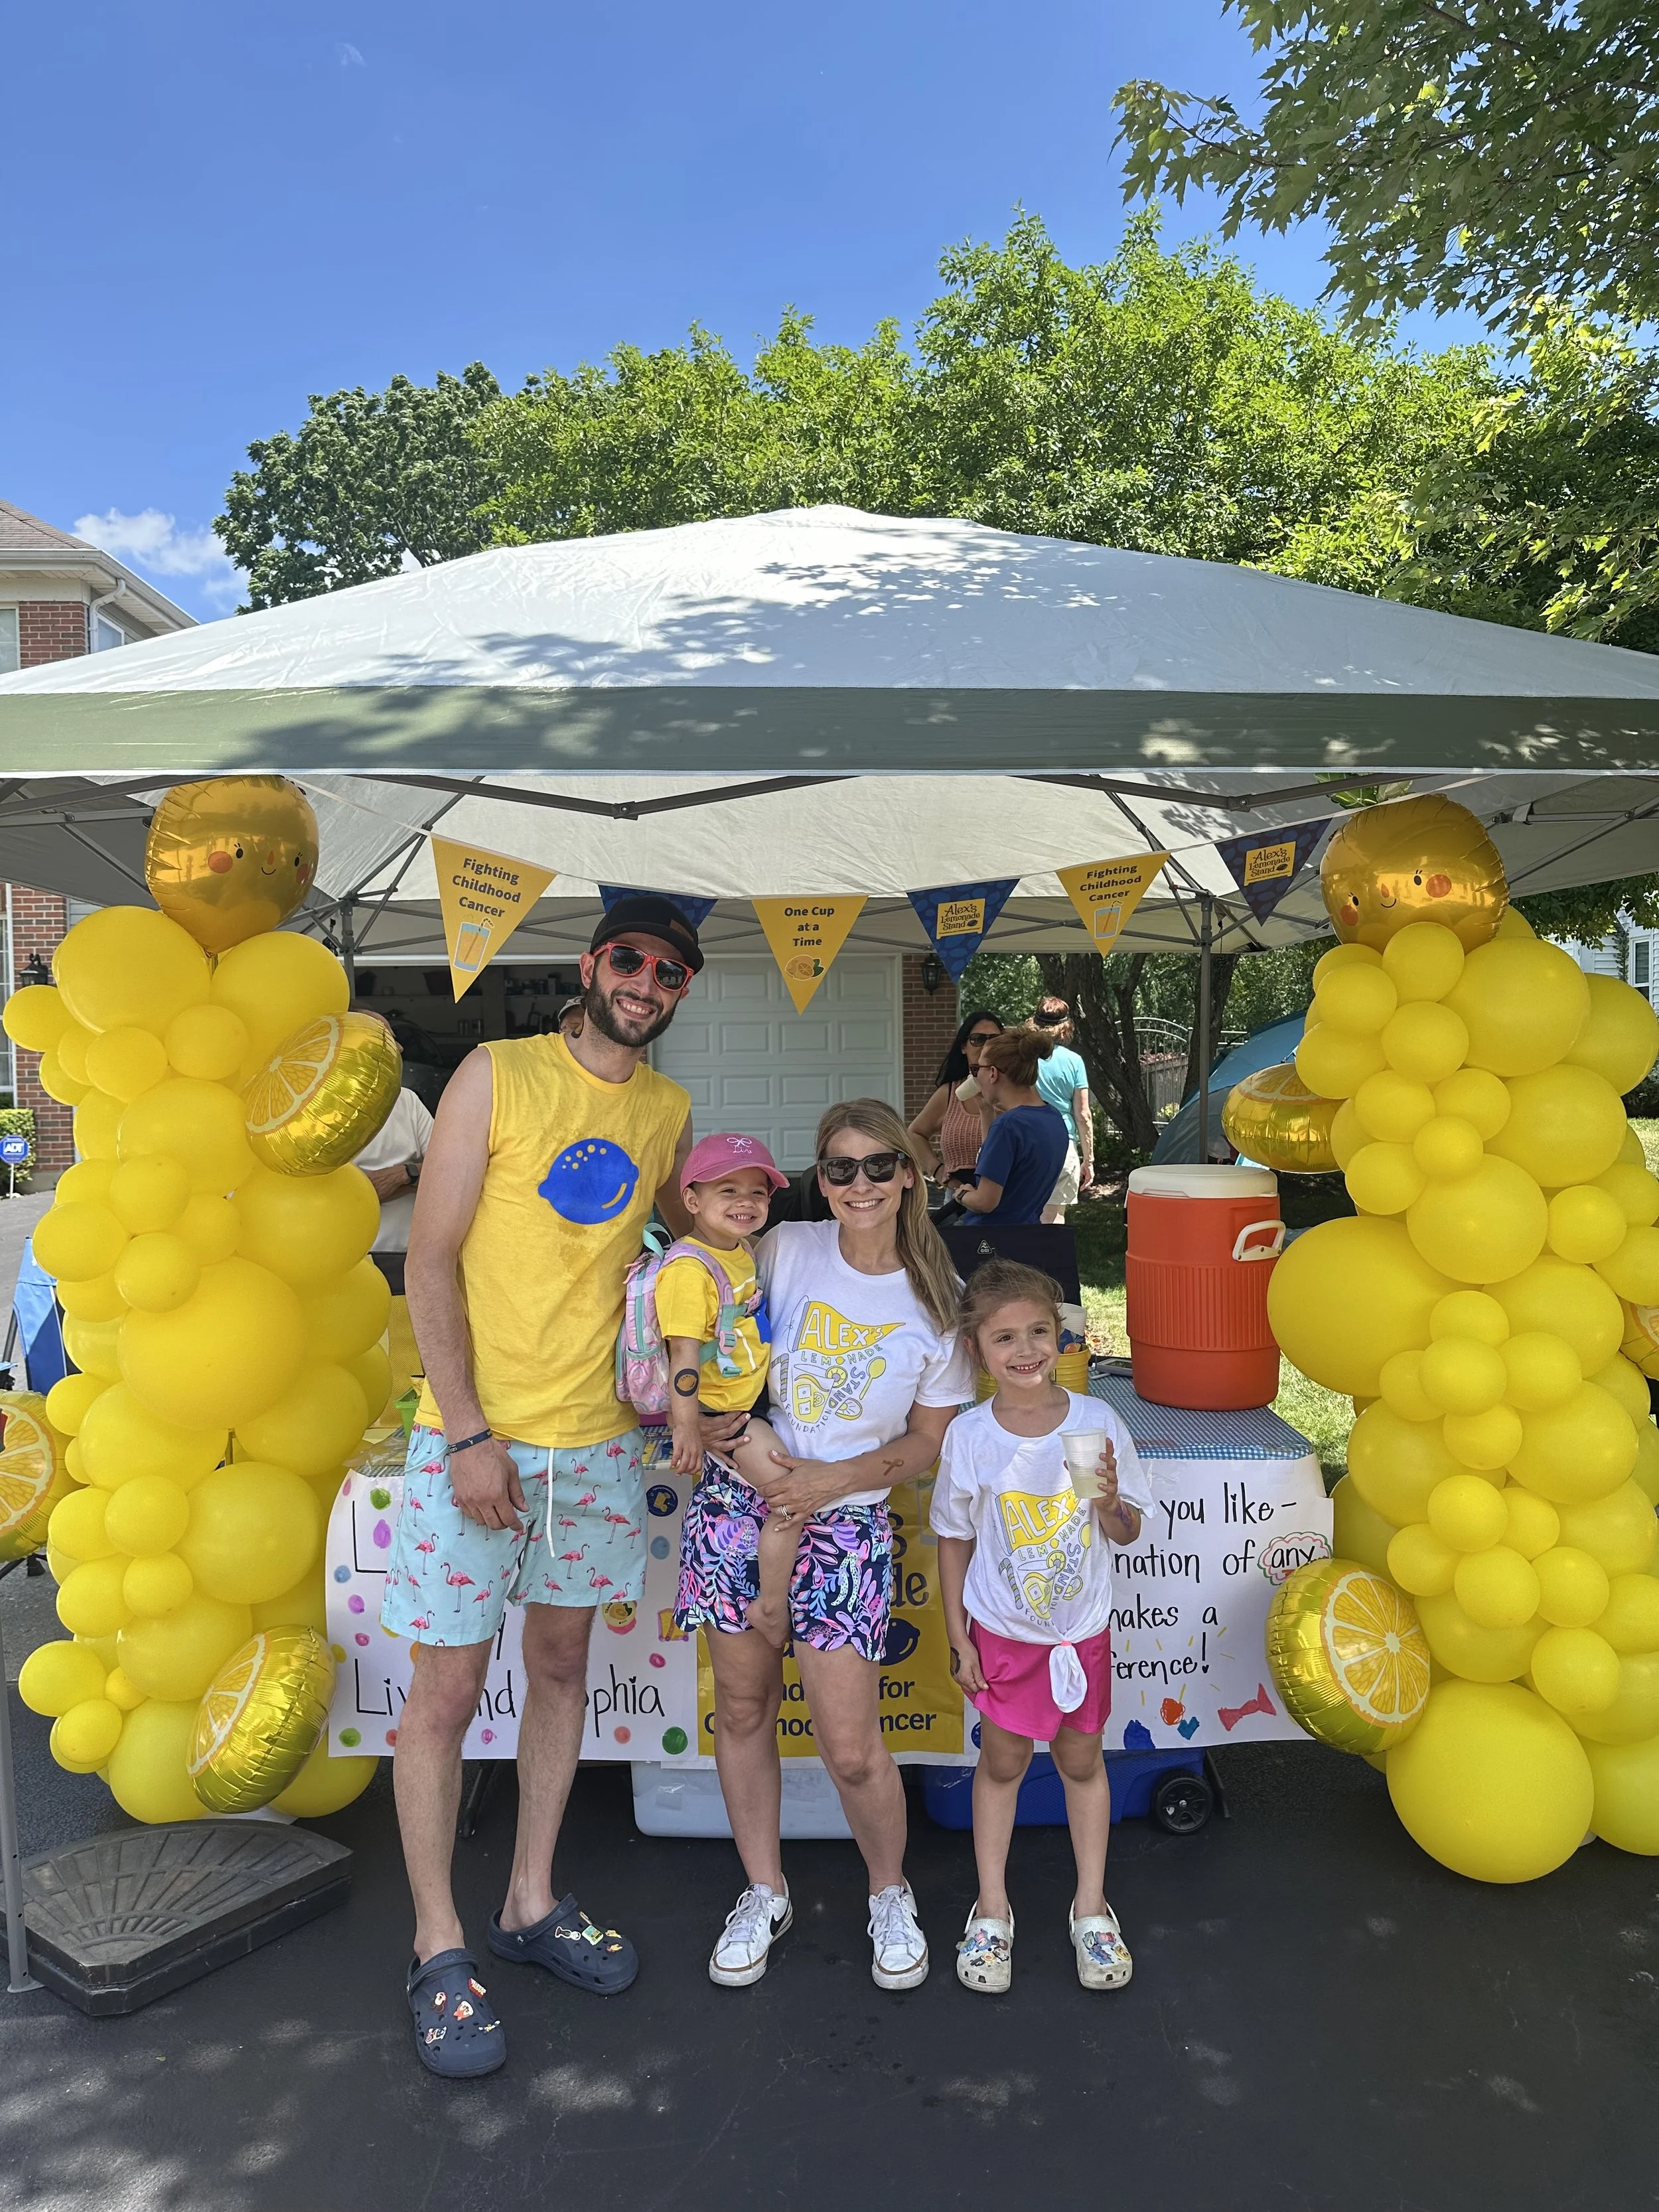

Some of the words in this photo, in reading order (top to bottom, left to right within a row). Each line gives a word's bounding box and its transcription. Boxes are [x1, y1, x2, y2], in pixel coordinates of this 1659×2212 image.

[1248, 856, 1291, 871] Lemonade
[1253, 848, 1287, 864] Alex's
[463, 857, 520, 886] Fighting
[1086, 864, 1139, 881] Fighting
[1251, 865, 1275, 877] Stand
[452, 874, 522, 903] Childhood
[1079, 875, 1142, 892] Childhood
[1088, 889, 1131, 903] Cancer
[459, 896, 506, 919] Cancer
[784, 906, 809, 917] One
[812, 905, 835, 919] Cup
[944, 903, 977, 917] Alex's
[797, 922, 810, 932] at
[812, 923, 820, 932] a
[940, 913, 981, 923] Lemonade
[942, 921, 966, 930] Stand
[792, 936, 822, 946] Time
[3, 1142, 25, 1153] ADT
[828, 1366, 866, 1409] STAND
[785, 1403, 832, 1434] FOUNDATION
[1159, 1497, 1205, 1540] you
[1054, 1542, 1082, 1595] STAND
[1114, 1544, 1200, 1584] nation
[1223, 1539, 1256, 1576] of
[1271, 1546, 1315, 1568] any
[1025, 1595, 1060, 1627] FOUNION
[1202, 1606, 1218, 1626] a
[879, 1675, 915, 1700] for
[477, 1669, 516, 1721] nd
[585, 1663, 666, 1738] phia
[879, 1712, 937, 1733] ncer
